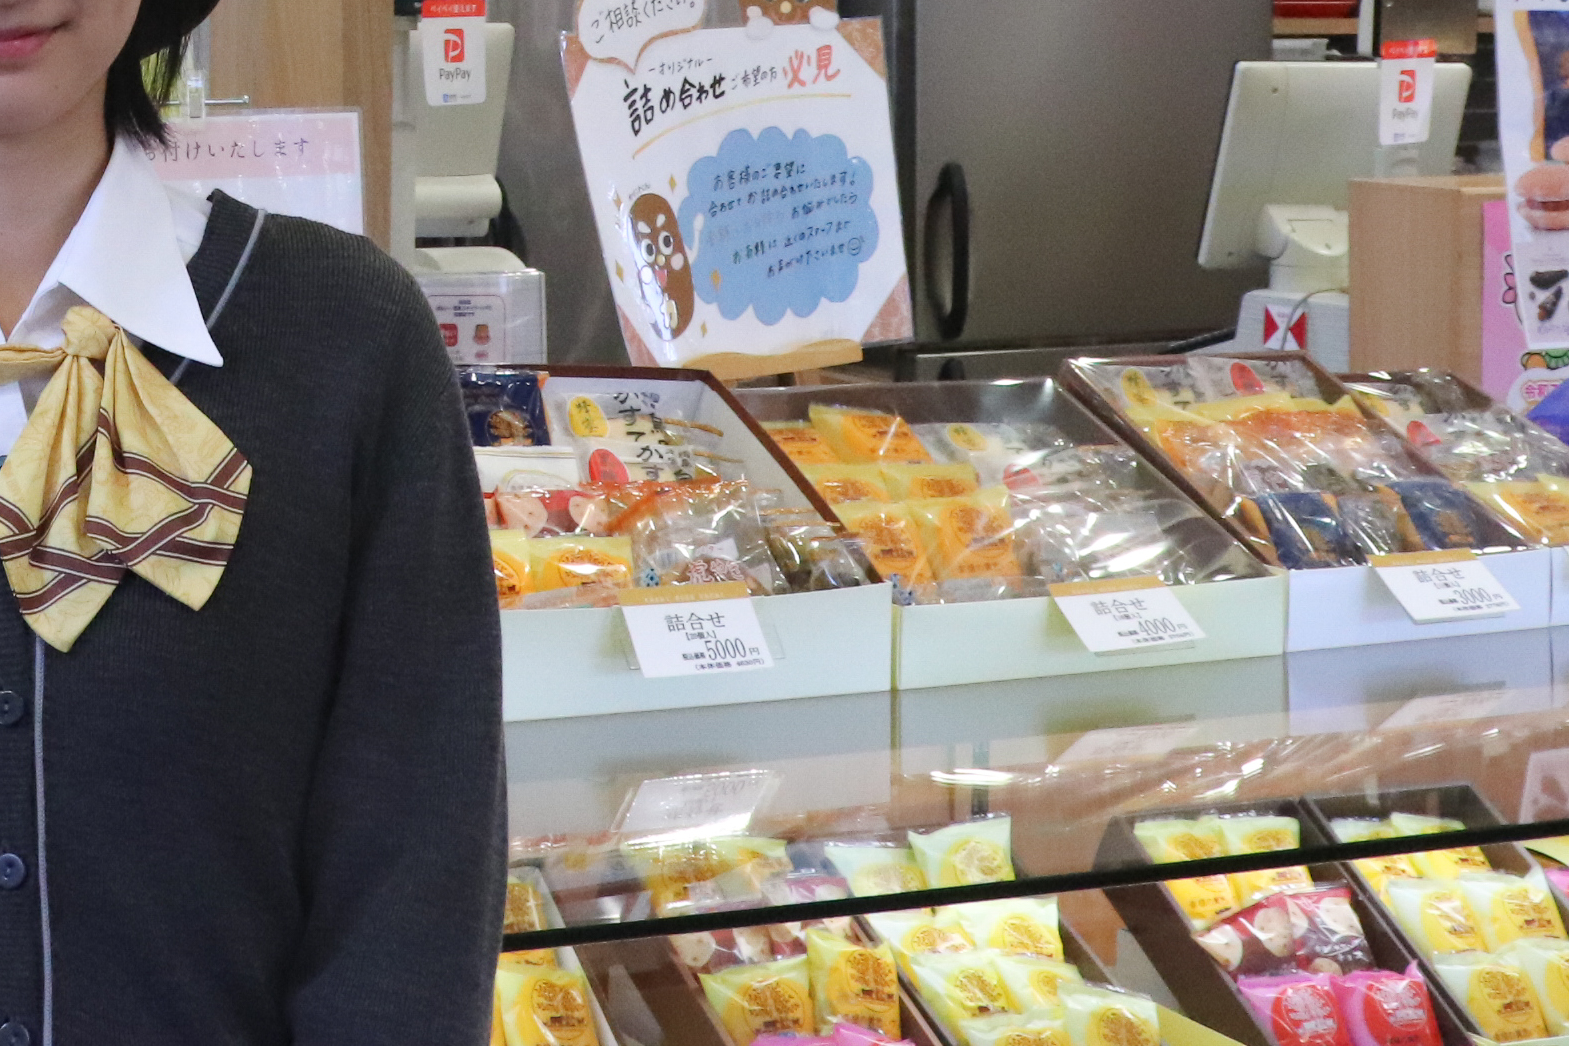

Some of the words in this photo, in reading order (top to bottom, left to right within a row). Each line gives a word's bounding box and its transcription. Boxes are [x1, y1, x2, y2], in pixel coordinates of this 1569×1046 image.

[438, 67, 471, 82] PayPay
[623, 73, 726, 137] 詰め合わせ
[783, 44, 840, 90] 必見
[1091, 598, 1148, 615] 詰合せ
[664, 612, 726, 633] 詰合せ
